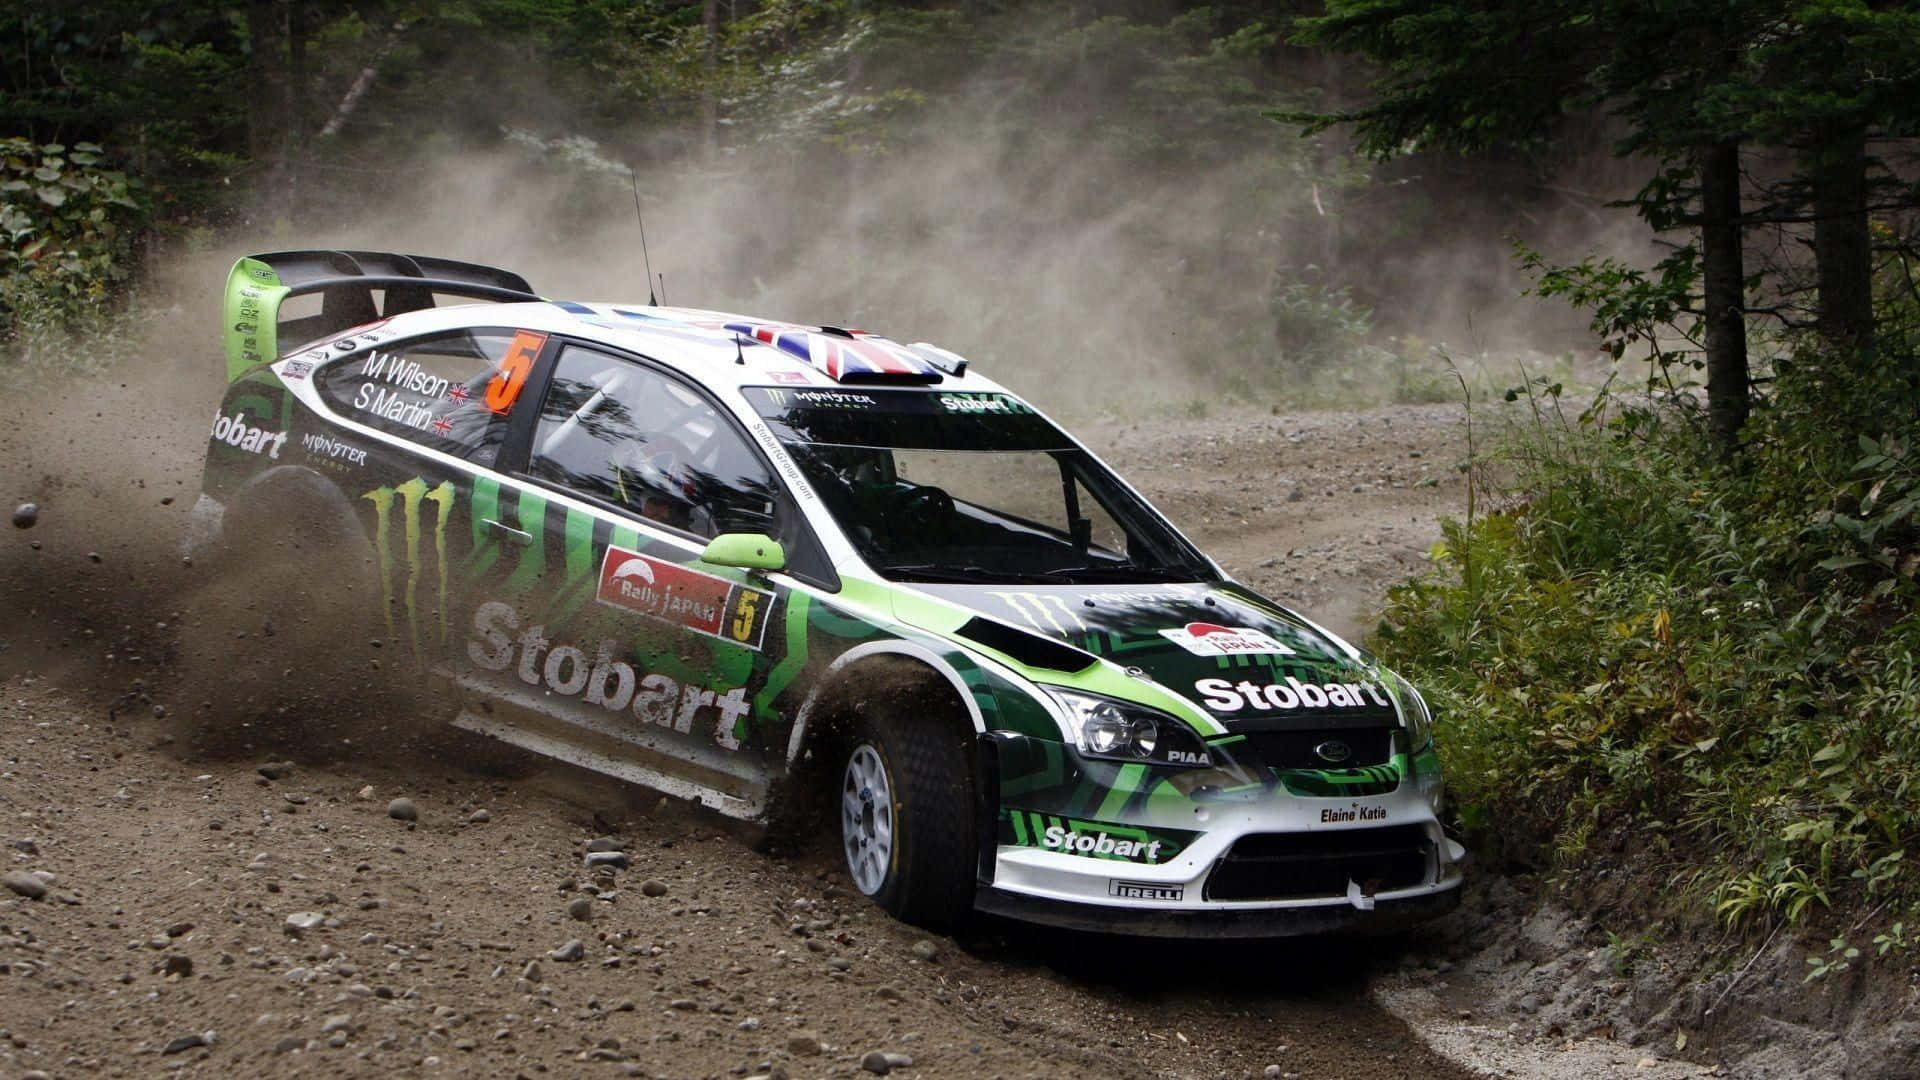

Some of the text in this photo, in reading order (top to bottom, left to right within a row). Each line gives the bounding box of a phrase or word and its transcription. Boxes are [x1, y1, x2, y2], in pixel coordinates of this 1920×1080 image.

[361, 350, 449, 399] M Wilson
[485, 332, 544, 411] 5
[354, 382, 433, 431] S Martin
[940, 396, 1009, 411] Stobart
[210, 408, 288, 459] tobart
[752, 423, 813, 500] StobartGroup.com
[621, 581, 658, 606] Rally
[732, 590, 760, 642] 5
[468, 601, 750, 750] Stobart
[1195, 676, 1390, 712] Stobart
[1167, 750, 1210, 764] PIAA
[1321, 805, 1387, 823] Elaine Katie
[1043, 825, 1161, 859] Stobart
[1109, 878, 1185, 902] PIRELLI
